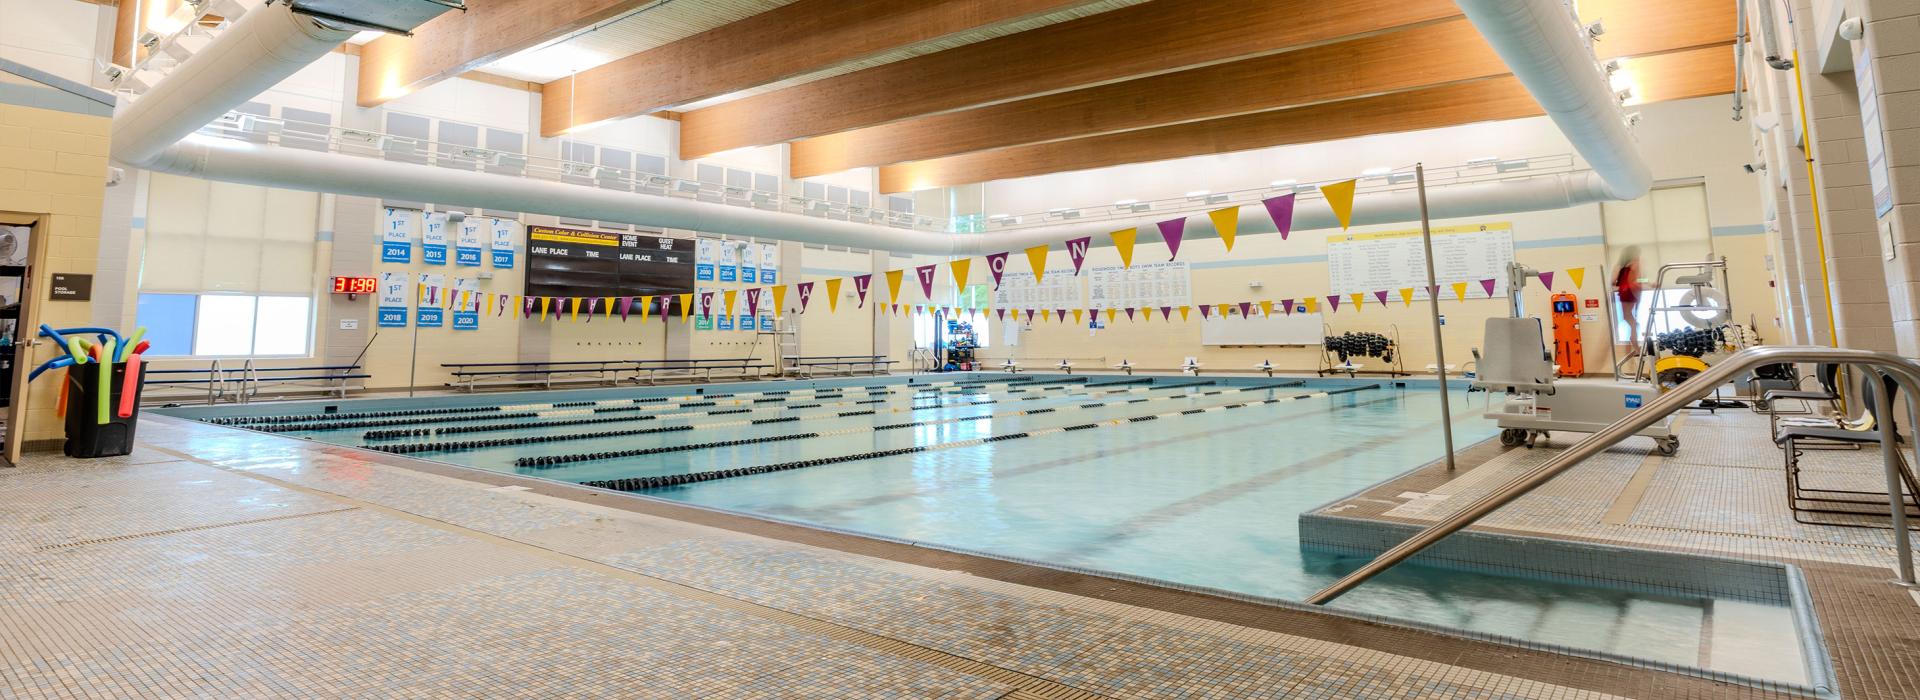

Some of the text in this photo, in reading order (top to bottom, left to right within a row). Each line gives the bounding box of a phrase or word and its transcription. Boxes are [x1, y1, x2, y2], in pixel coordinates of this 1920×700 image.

[387, 248, 405, 257] 2014
[425, 250, 442, 259] 2015
[531, 246, 568, 256] LANE PLACE
[460, 253, 477, 261] 2016
[634, 254, 652, 262] PLACE
[335, 277, 376, 292] 31:98
[383, 313, 401, 321] 2018
[457, 317, 474, 325] 2020
